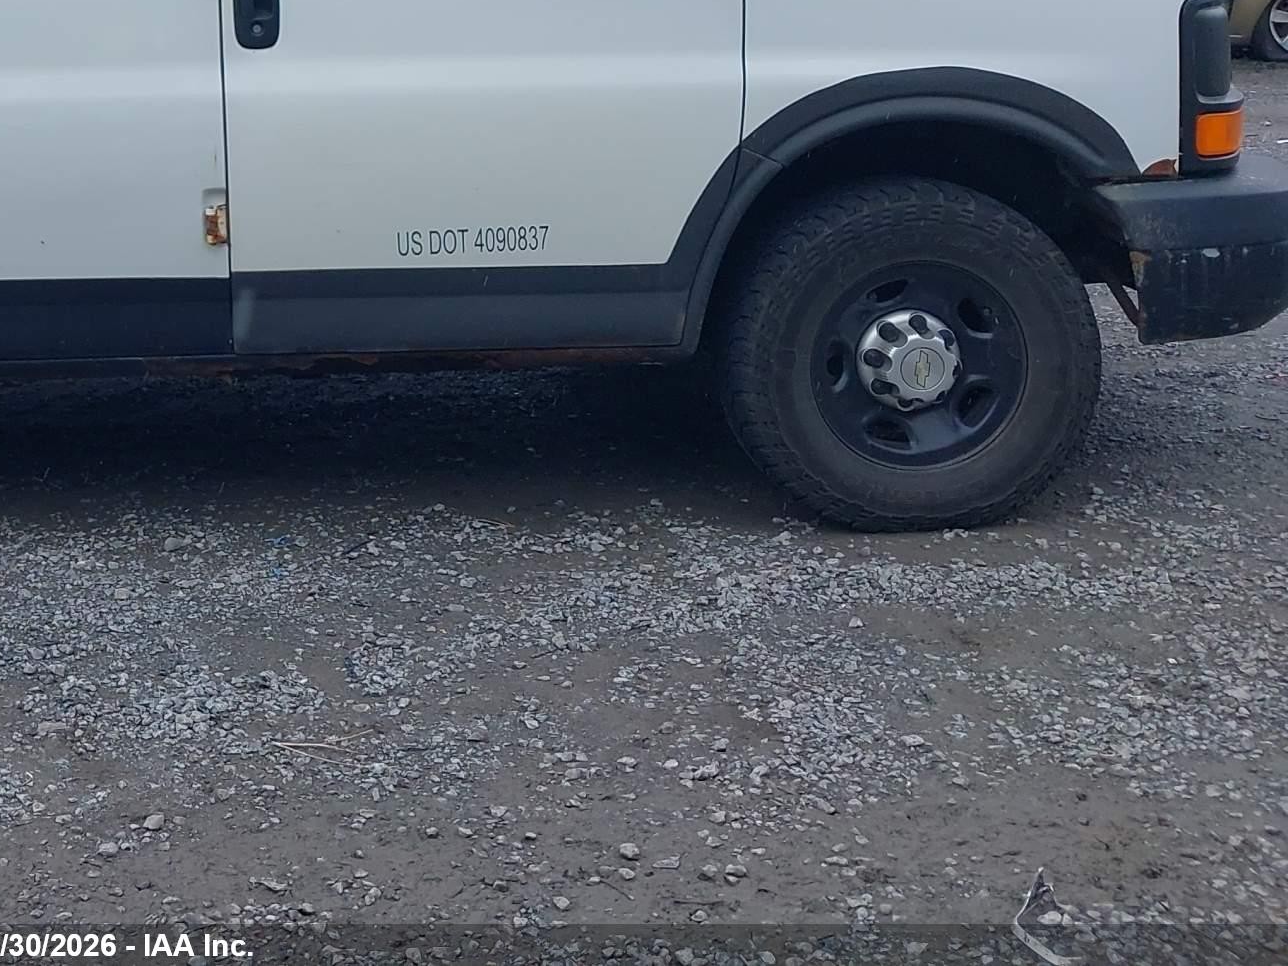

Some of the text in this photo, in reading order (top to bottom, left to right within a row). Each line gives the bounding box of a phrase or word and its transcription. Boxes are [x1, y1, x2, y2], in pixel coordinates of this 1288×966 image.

[397, 225, 549, 256] US DOT 4090837
